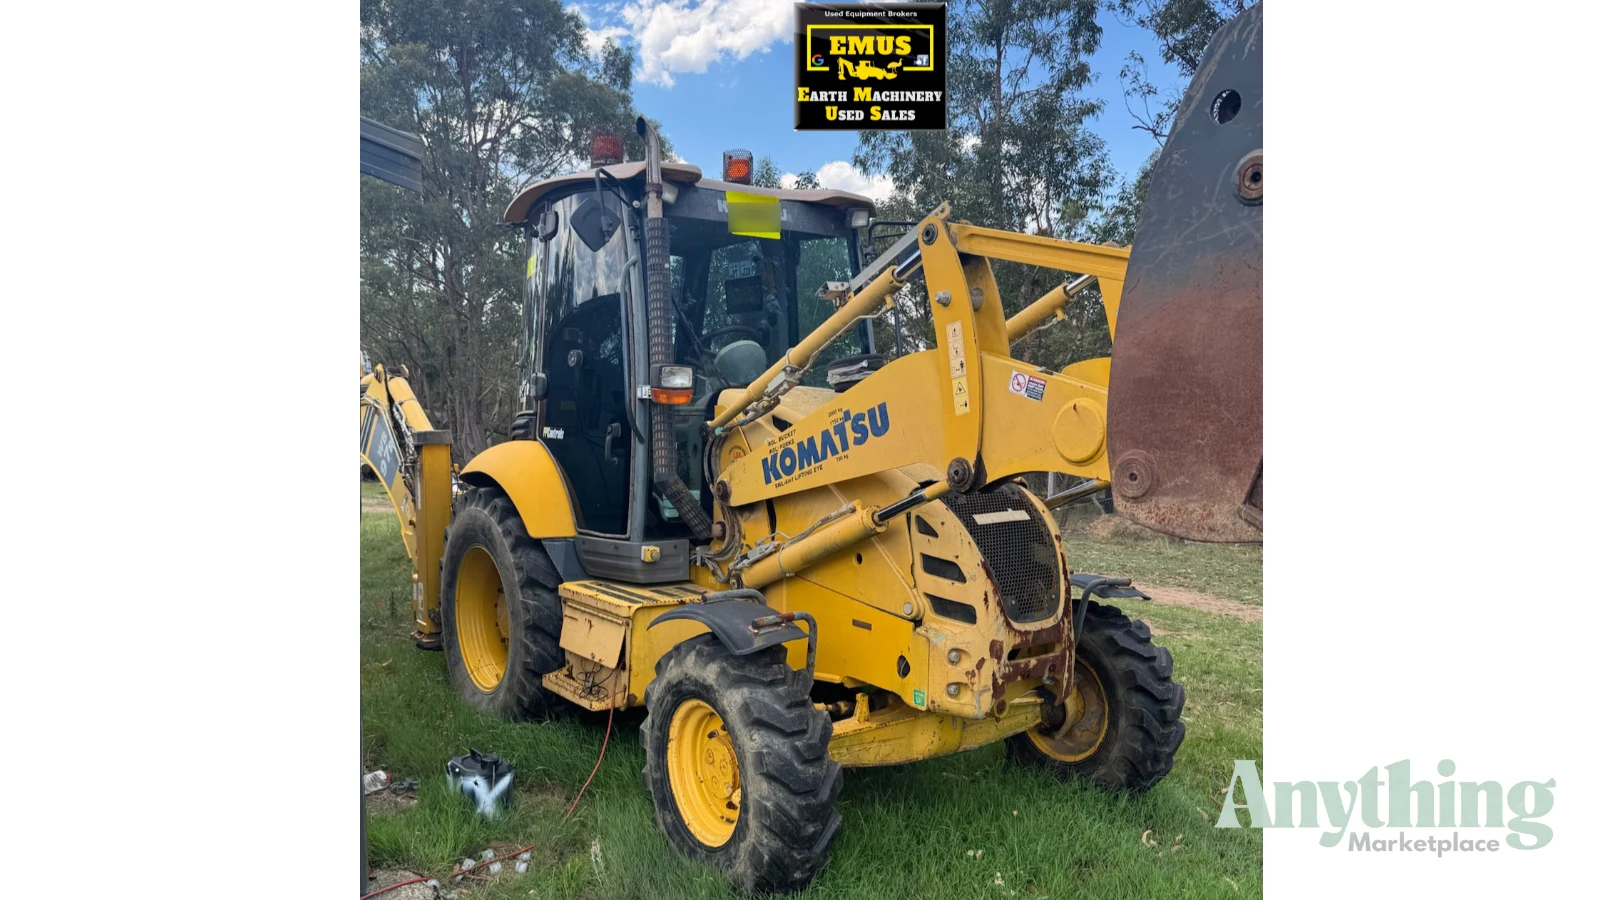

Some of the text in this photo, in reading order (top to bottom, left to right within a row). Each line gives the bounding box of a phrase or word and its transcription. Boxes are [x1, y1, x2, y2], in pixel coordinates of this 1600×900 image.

[761, 401, 890, 485] KOMATSU
[778, 429, 797, 443] BUCKET
[813, 464, 824, 474] EYE
